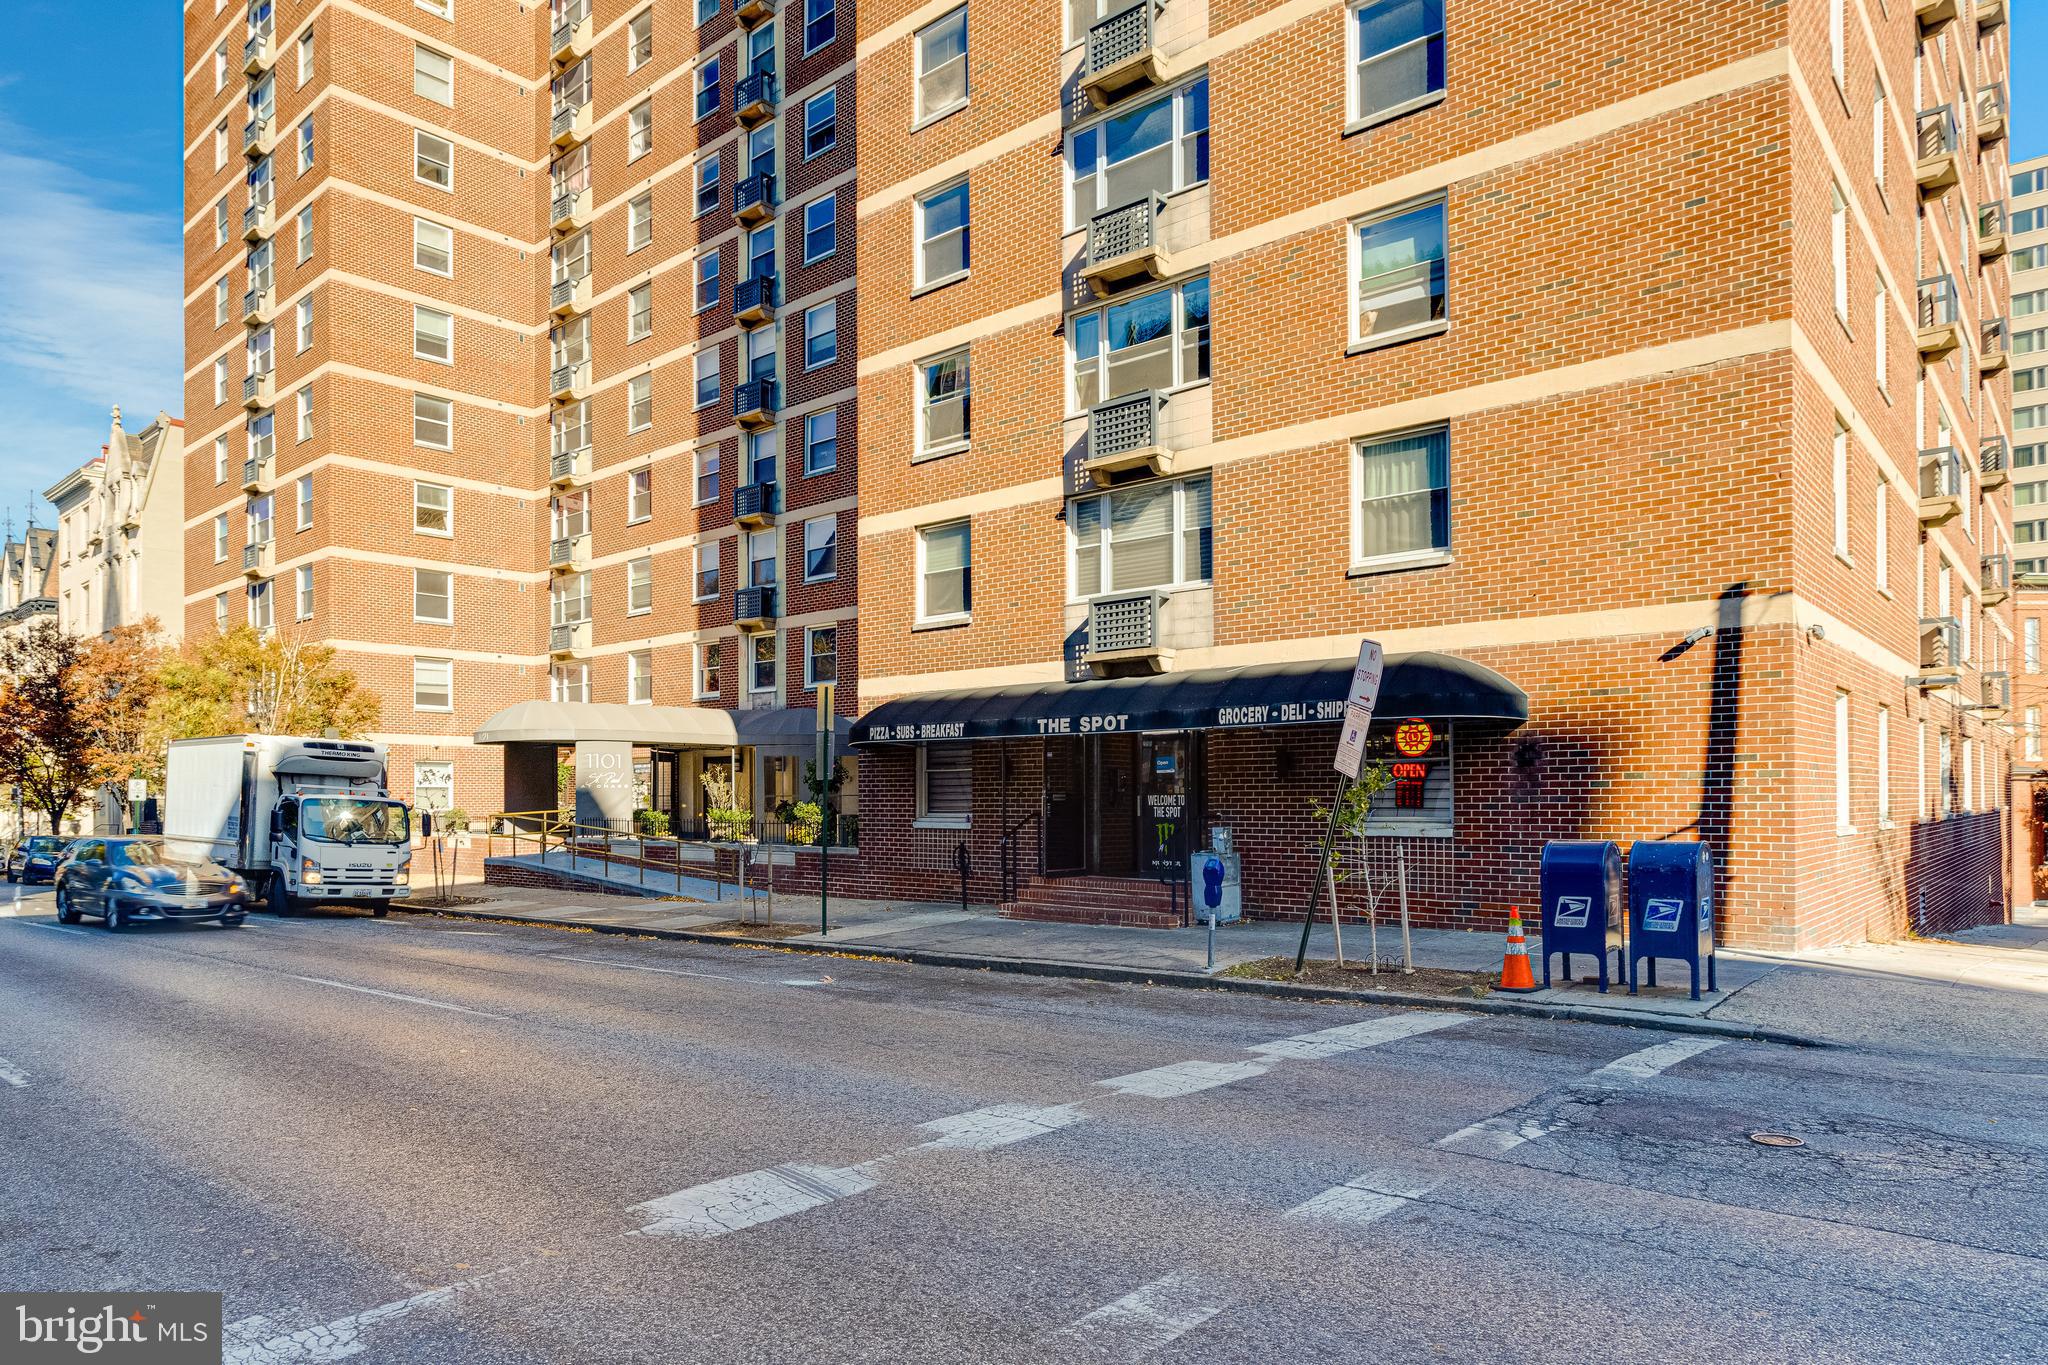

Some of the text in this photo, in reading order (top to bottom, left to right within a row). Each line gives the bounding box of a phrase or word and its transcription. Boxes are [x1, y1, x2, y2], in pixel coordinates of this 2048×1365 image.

[1369, 648, 1377, 661] NO
[1357, 669, 1378, 685] STOPPING
[1218, 706, 1269, 725] GROCERY
[1281, 703, 1306, 721] DELI
[869, 723, 965, 740] PIZZA SUBS BREAKFAST
[1037, 714, 1129, 734] THE SPOT
[585, 753, 622, 769] 1101
[1393, 763, 1425, 778] OPEN
[1147, 795, 1185, 806] WELCOME TO
[1153, 806, 1181, 818] THE SPOT
